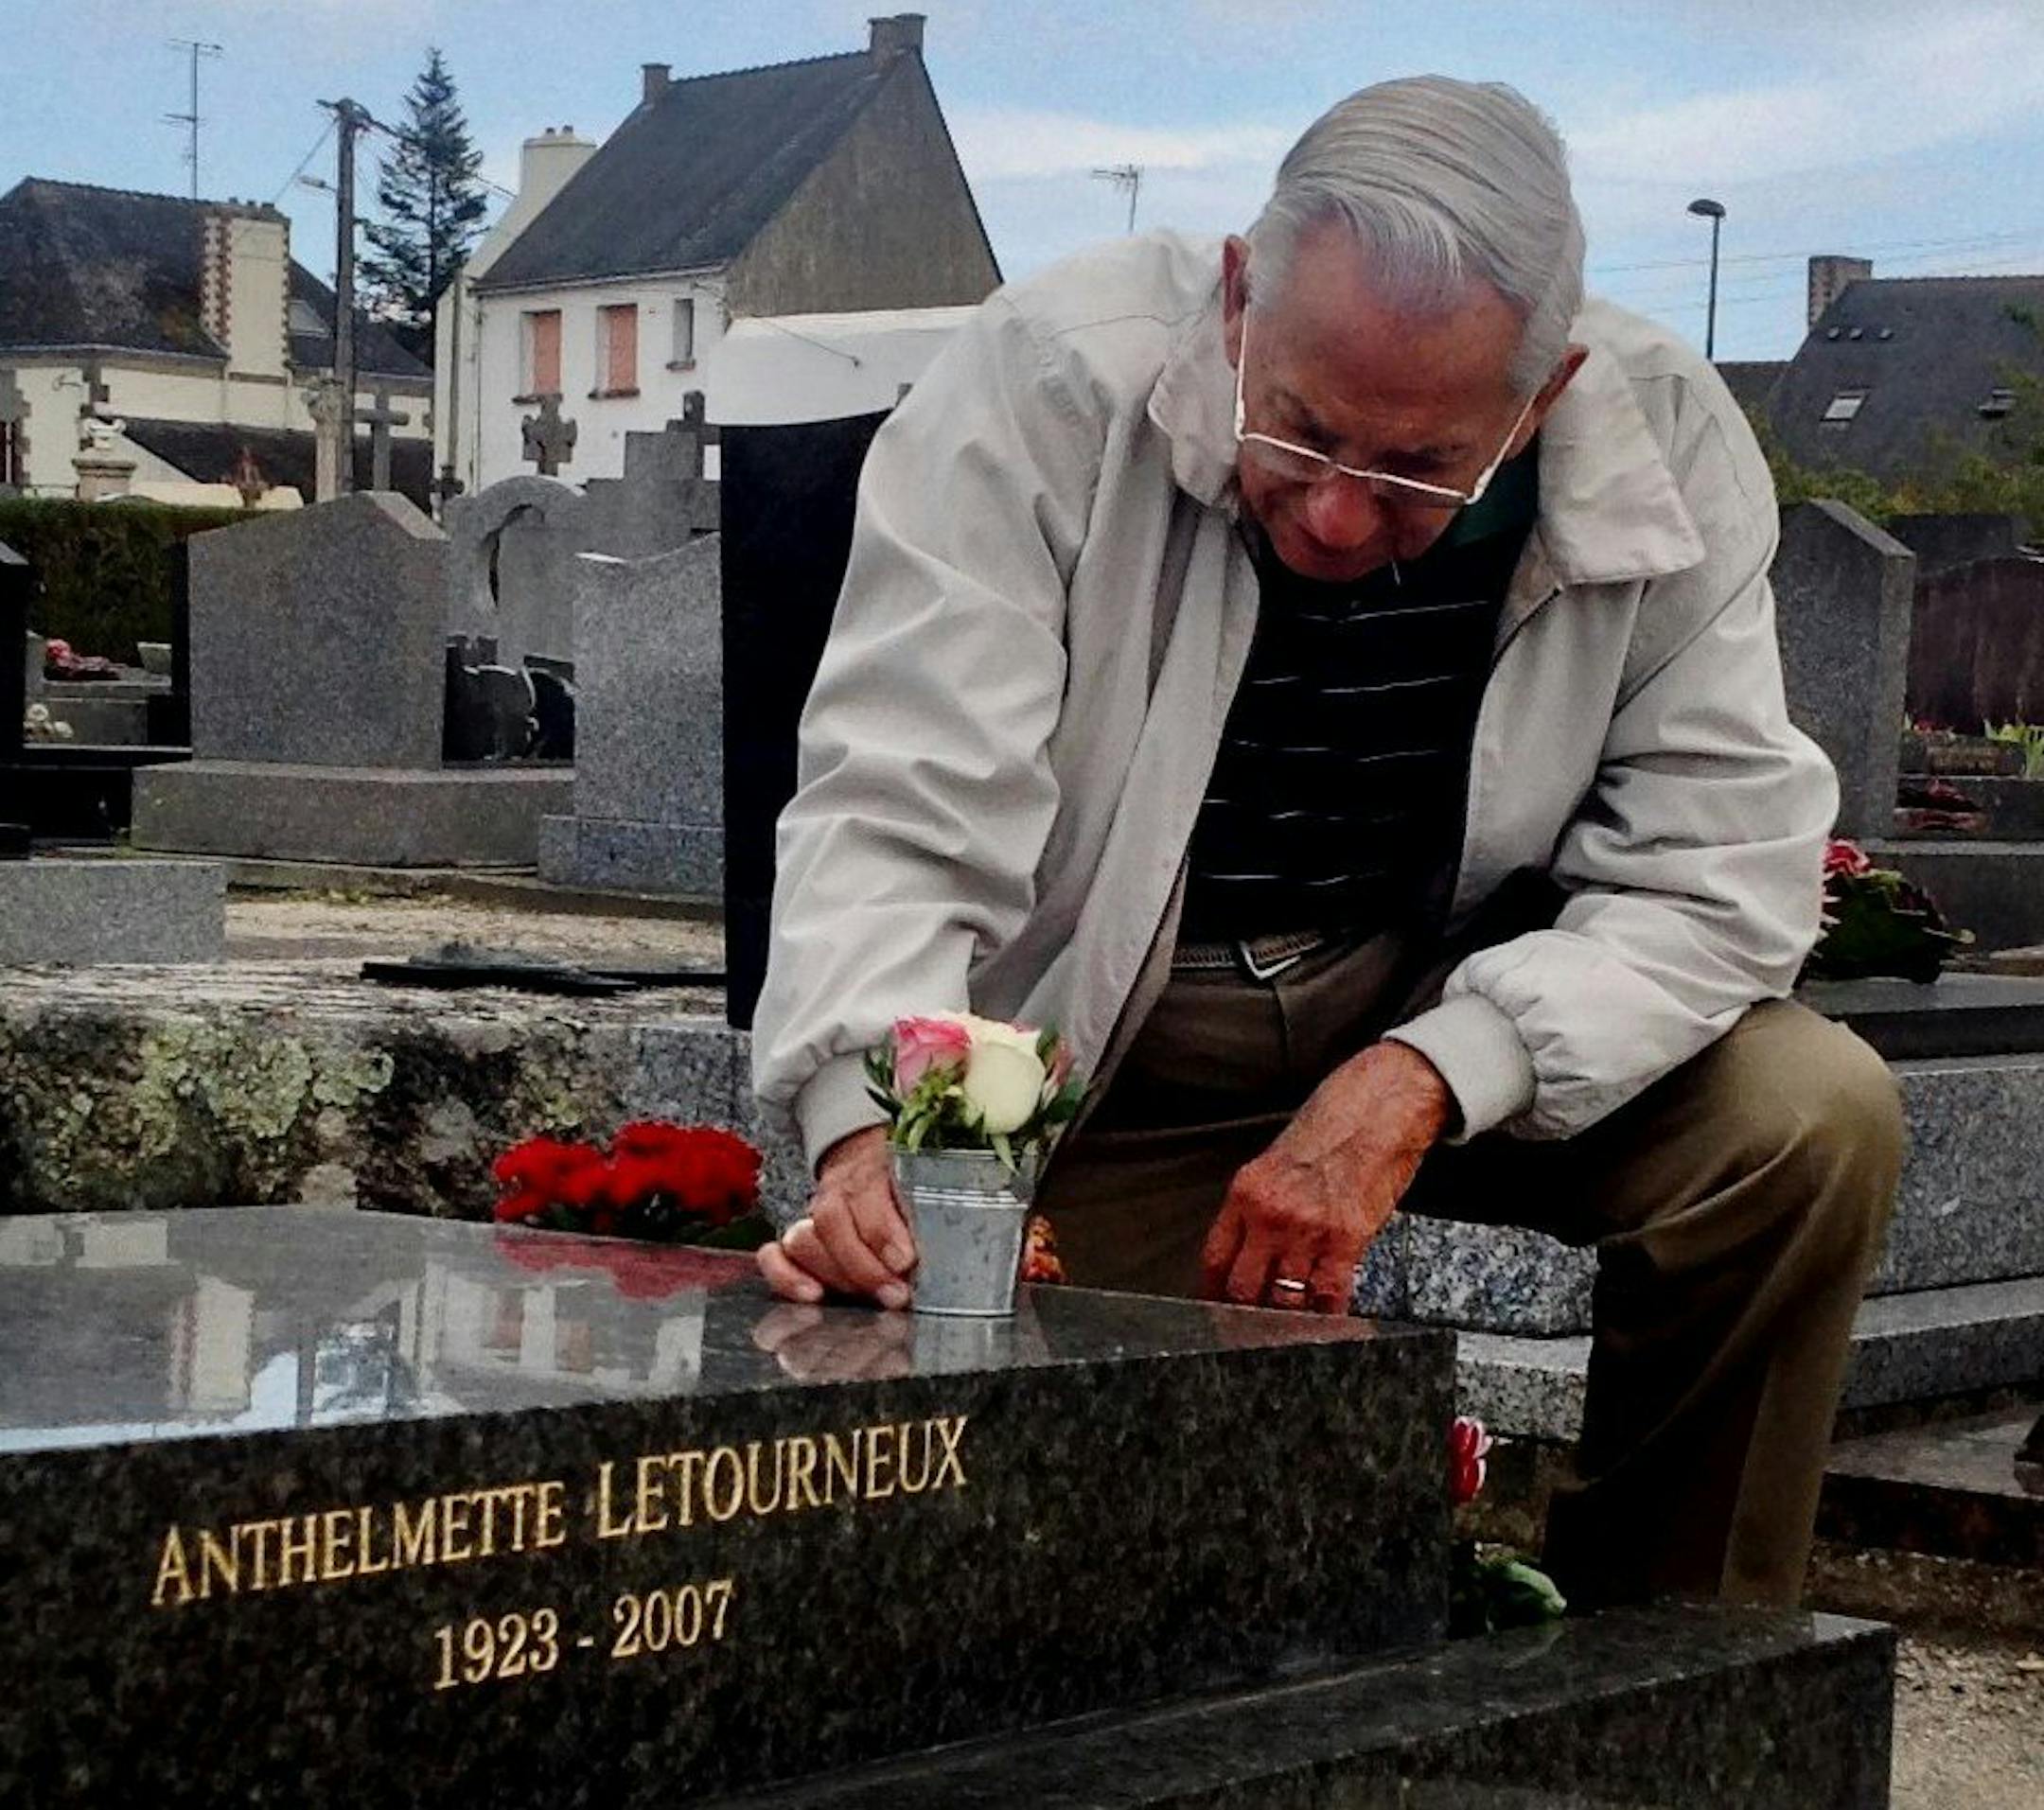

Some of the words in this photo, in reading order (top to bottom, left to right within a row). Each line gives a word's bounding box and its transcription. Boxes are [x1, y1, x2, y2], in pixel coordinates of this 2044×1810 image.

[151, 1481, 566, 1606] ANTHELMETTE
[597, 1415, 969, 1539] LETOURNEUX
[433, 1607, 560, 1691] 1923
[575, 1636, 594, 1649] -
[610, 1579, 734, 1659] 2007
